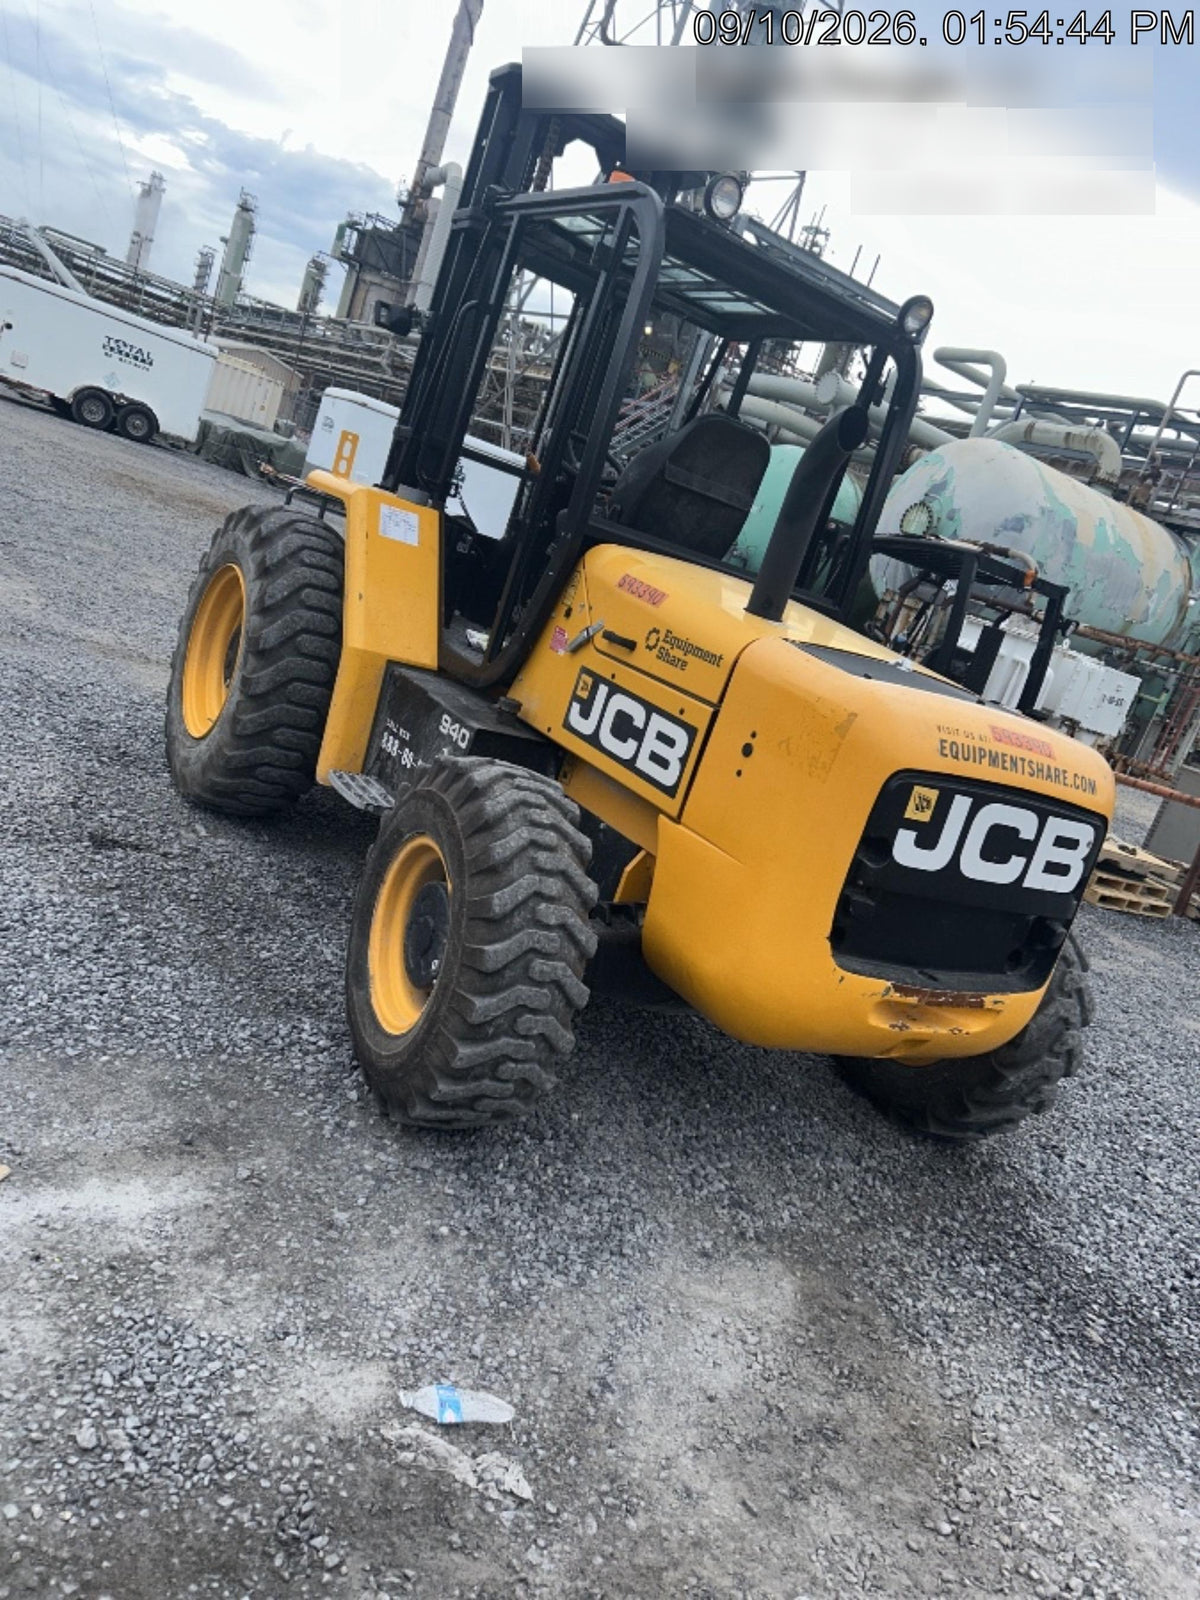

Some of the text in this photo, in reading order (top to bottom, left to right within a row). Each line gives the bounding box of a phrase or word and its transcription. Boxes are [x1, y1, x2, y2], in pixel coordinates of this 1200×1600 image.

[656, 647, 689, 671] Share
[662, 628, 725, 668] Equipment
[439, 713, 470, 749] 940
[568, 683, 689, 787] JCB
[939, 739, 1097, 796] EQUIPMENTSHARE.COM
[892, 794, 1096, 893] JCB
